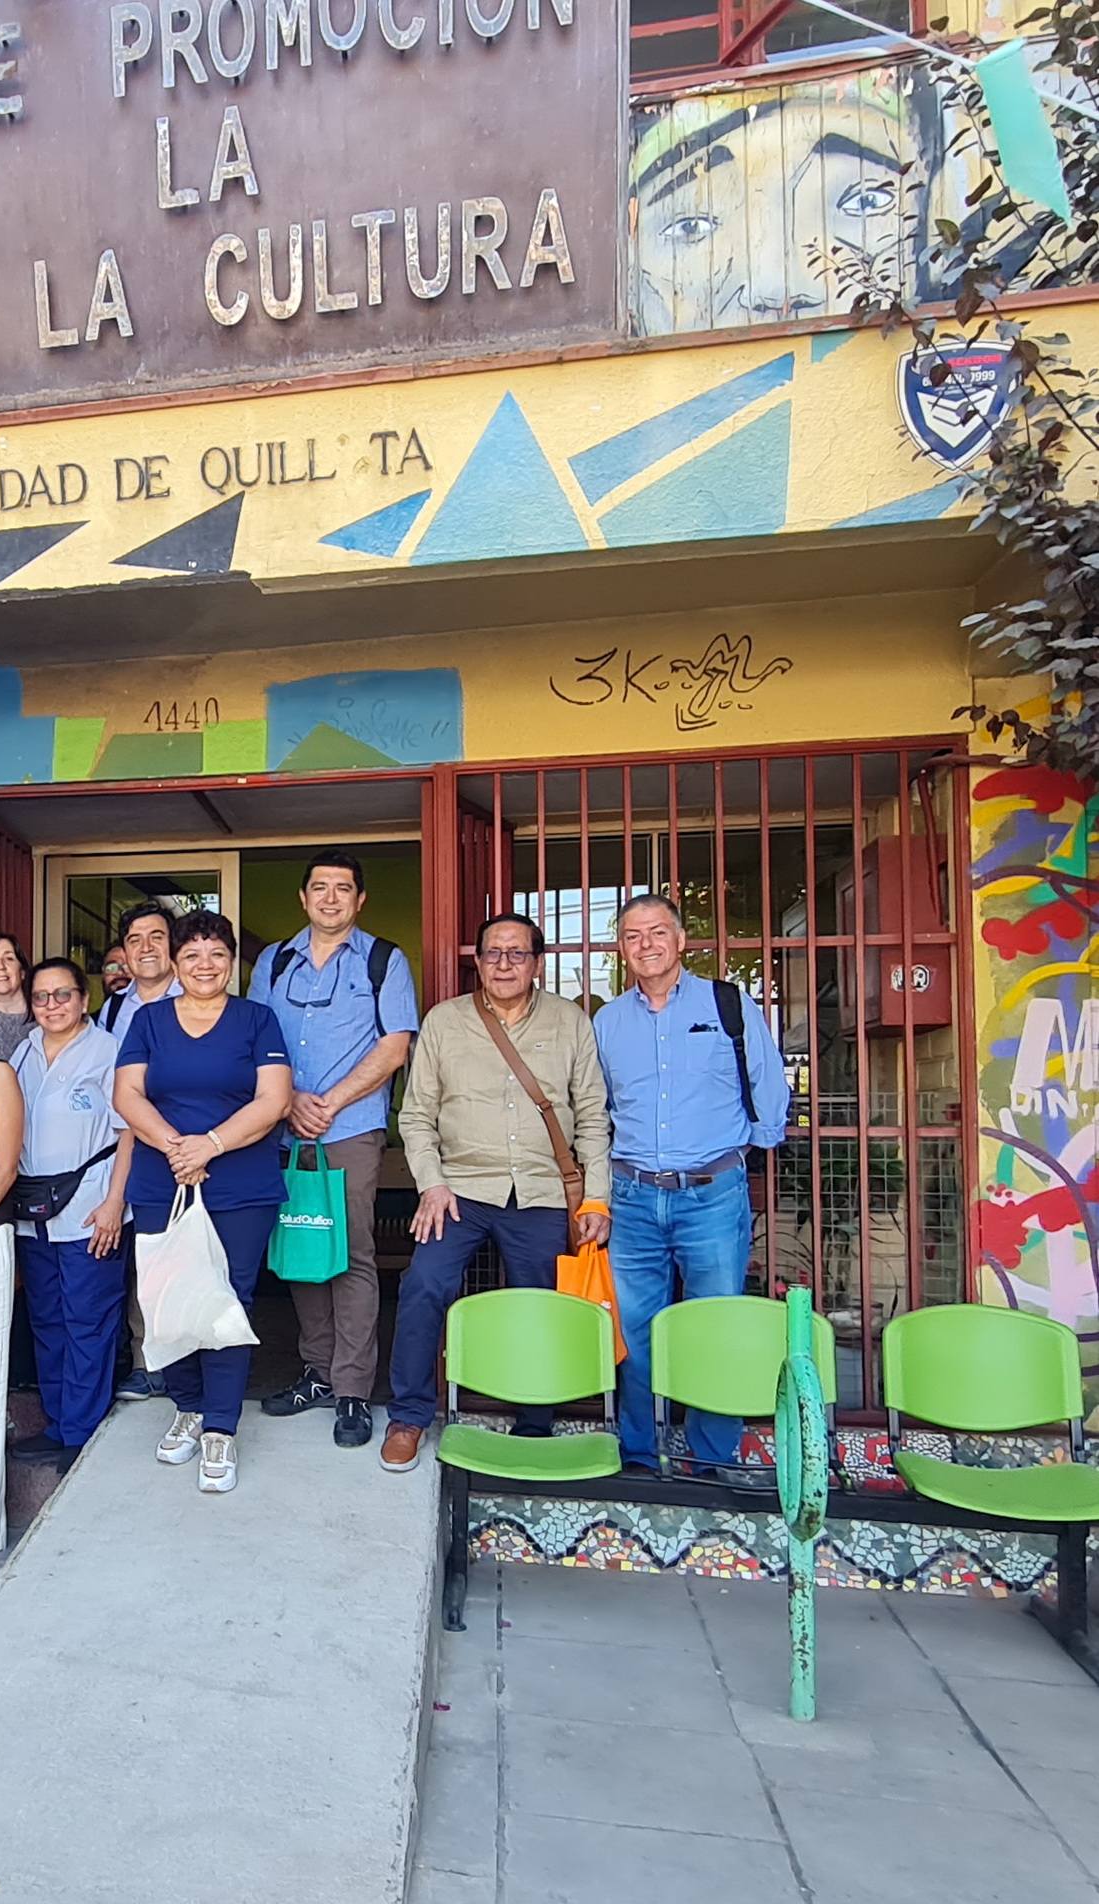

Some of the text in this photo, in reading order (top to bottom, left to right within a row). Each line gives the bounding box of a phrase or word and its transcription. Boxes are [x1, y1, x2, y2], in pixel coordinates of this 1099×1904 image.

[110, 0, 574, 97] PROMOC
[156, 105, 258, 209] LA
[33, 248, 134, 349] LA
[204, 188, 575, 326] CULTURA
[113, 455, 171, 501] DE
[200, 427, 433, 495] QUILLTA
[143, 697, 220, 731] 1440
